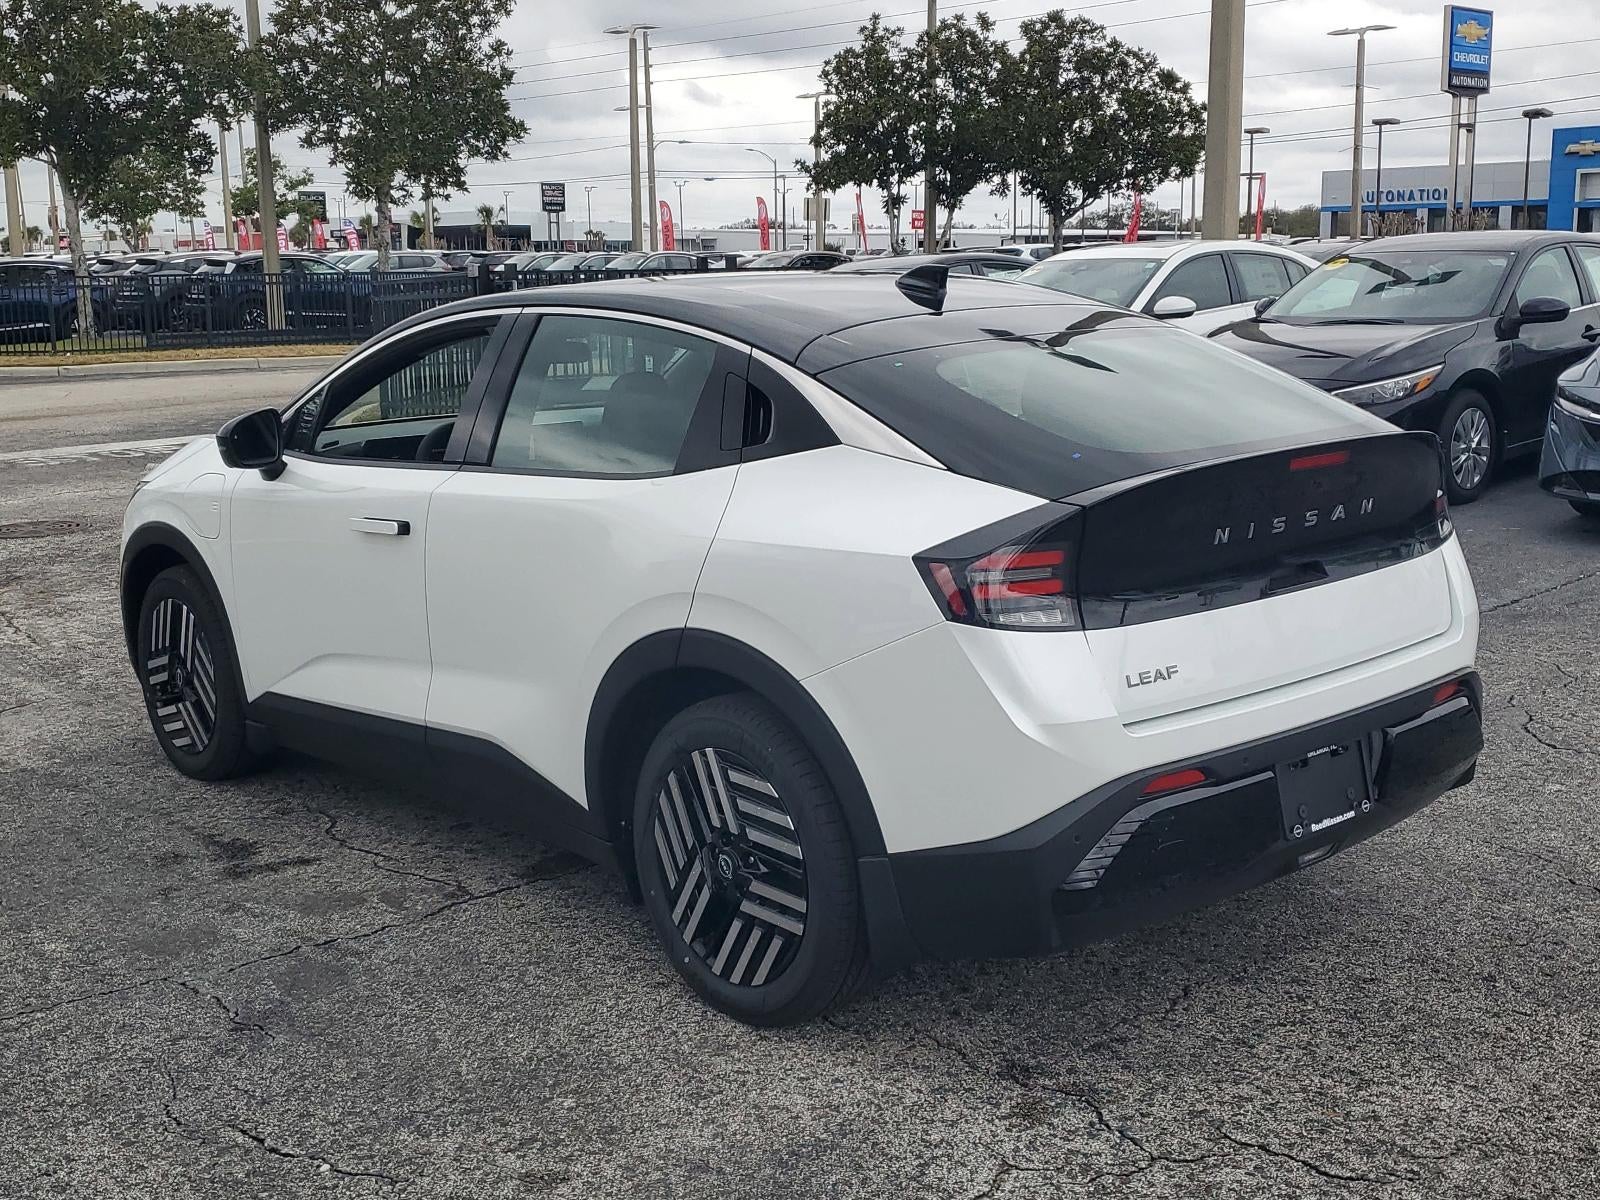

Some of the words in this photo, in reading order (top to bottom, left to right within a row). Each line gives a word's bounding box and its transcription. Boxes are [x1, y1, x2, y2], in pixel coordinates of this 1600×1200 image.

[1453, 51, 1489, 65] CHEVROLET
[1452, 75, 1488, 88] AUTONATION
[1361, 188, 1448, 204] UTONATIO
[1213, 497, 1375, 545] NISSAN
[1125, 664, 1179, 689] LEAF
[1311, 810, 1356, 832] ReedNissan.com
